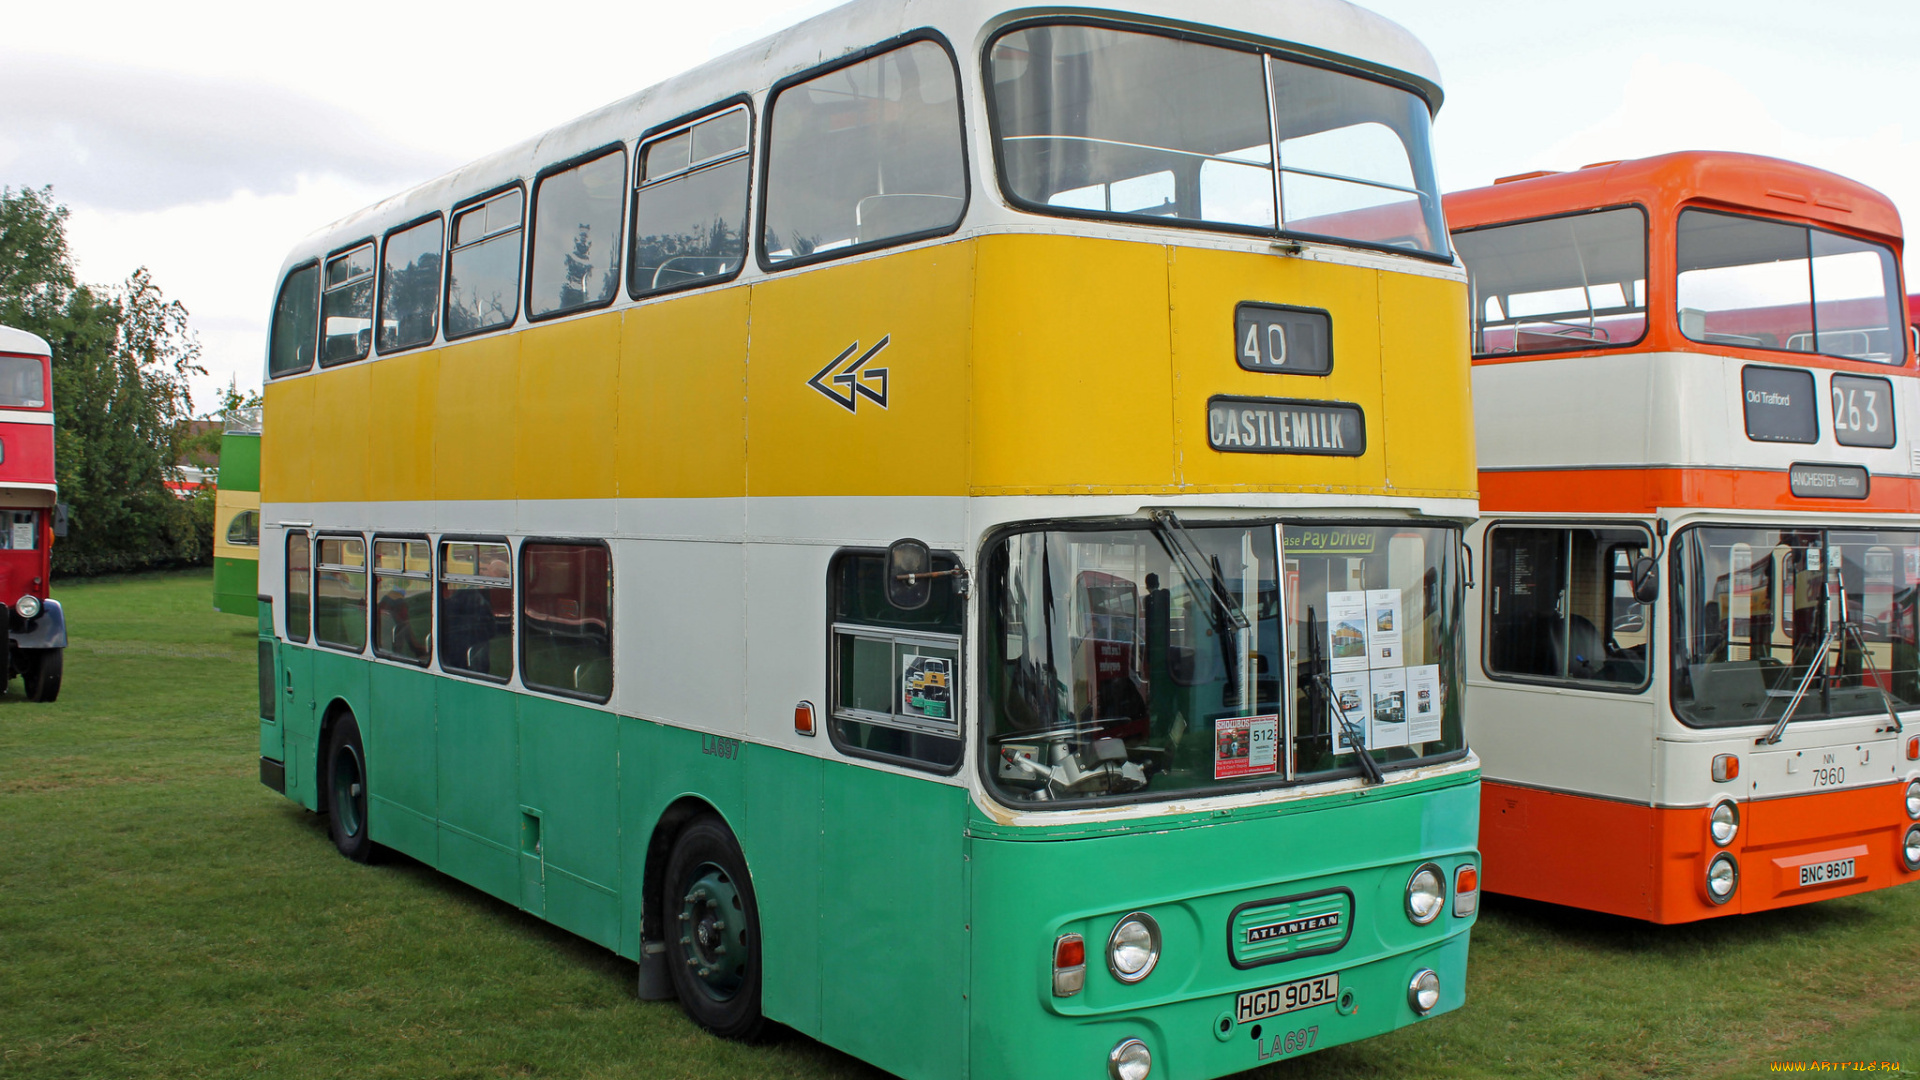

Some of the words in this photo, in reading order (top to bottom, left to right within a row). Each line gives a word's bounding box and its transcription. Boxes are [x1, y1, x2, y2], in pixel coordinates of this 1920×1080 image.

[1244, 323, 1287, 365] 40
[1747, 390, 1760, 403] Old
[1761, 391, 1790, 406] Trafford
[1832, 387, 1878, 432] 263
[1210, 409, 1344, 448] CASTLEMILK
[1302, 531, 1328, 549] Pay
[1330, 530, 1372, 546] Driver
[702, 735, 740, 761] LA697
[1253, 729, 1274, 742] 512
[1823, 754, 1835, 764] NN
[1812, 767, 1845, 787] 7960
[1801, 865, 1824, 884] BNC
[1827, 860, 1854, 878] 960T
[1250, 915, 1338, 941] ATLANTEAN
[1240, 989, 1280, 1020] HGD
[1286, 978, 1336, 1009] 903L
[1258, 1025, 1319, 1061] LA697
